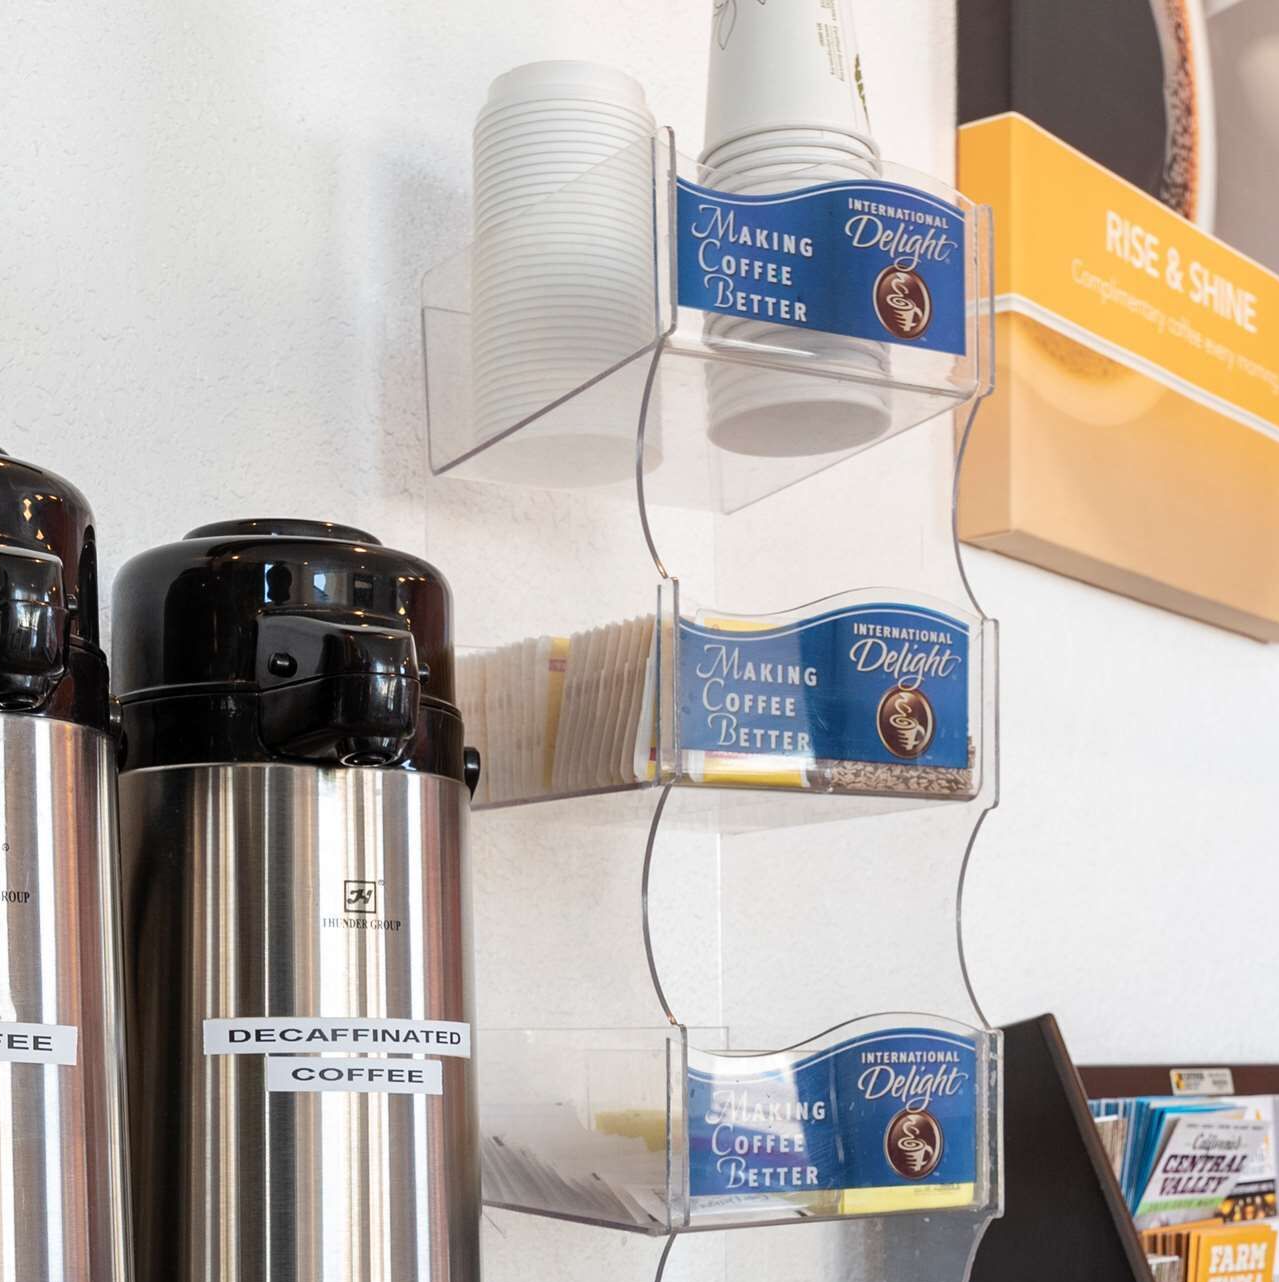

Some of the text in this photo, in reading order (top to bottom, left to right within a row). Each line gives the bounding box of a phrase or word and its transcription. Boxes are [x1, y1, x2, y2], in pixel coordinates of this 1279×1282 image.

[848, 197, 950, 229] INTERNATIONAL
[691, 204, 813, 257] MAKING
[845, 214, 959, 271] Delight
[698, 239, 793, 286] COFFEE
[1106, 209, 1259, 334] RISE & SHINE
[704, 274, 808, 322] BETTER
[1071, 256, 1166, 335] Complimentary
[1167, 315, 1201, 349] coffee
[1203, 337, 1234, 372] every
[853, 622, 953, 645] INTERNATIONAL
[696, 644, 818, 687] MAKING
[849, 638, 962, 691] Delight
[702, 678, 796, 717] COFFEE
[707, 713, 811, 751] BETTER
[322, 917, 402, 931] THUNDER GROUP
[228, 1028, 461, 1045] DECAFFINATED
[861, 1050, 961, 1064] INTERNATIONAL
[291, 1067, 424, 1083] COFFEE
[857, 1065, 969, 1112] Delight
[705, 1090, 826, 1124] MAKING
[711, 1124, 806, 1156] COFFEE
[717, 1156, 819, 1189] BETTER
[1161, 1154, 1248, 1174] CENTRAL
[1158, 1176, 1229, 1196] VALLEY
[1208, 1242, 1269, 1274] FARM
